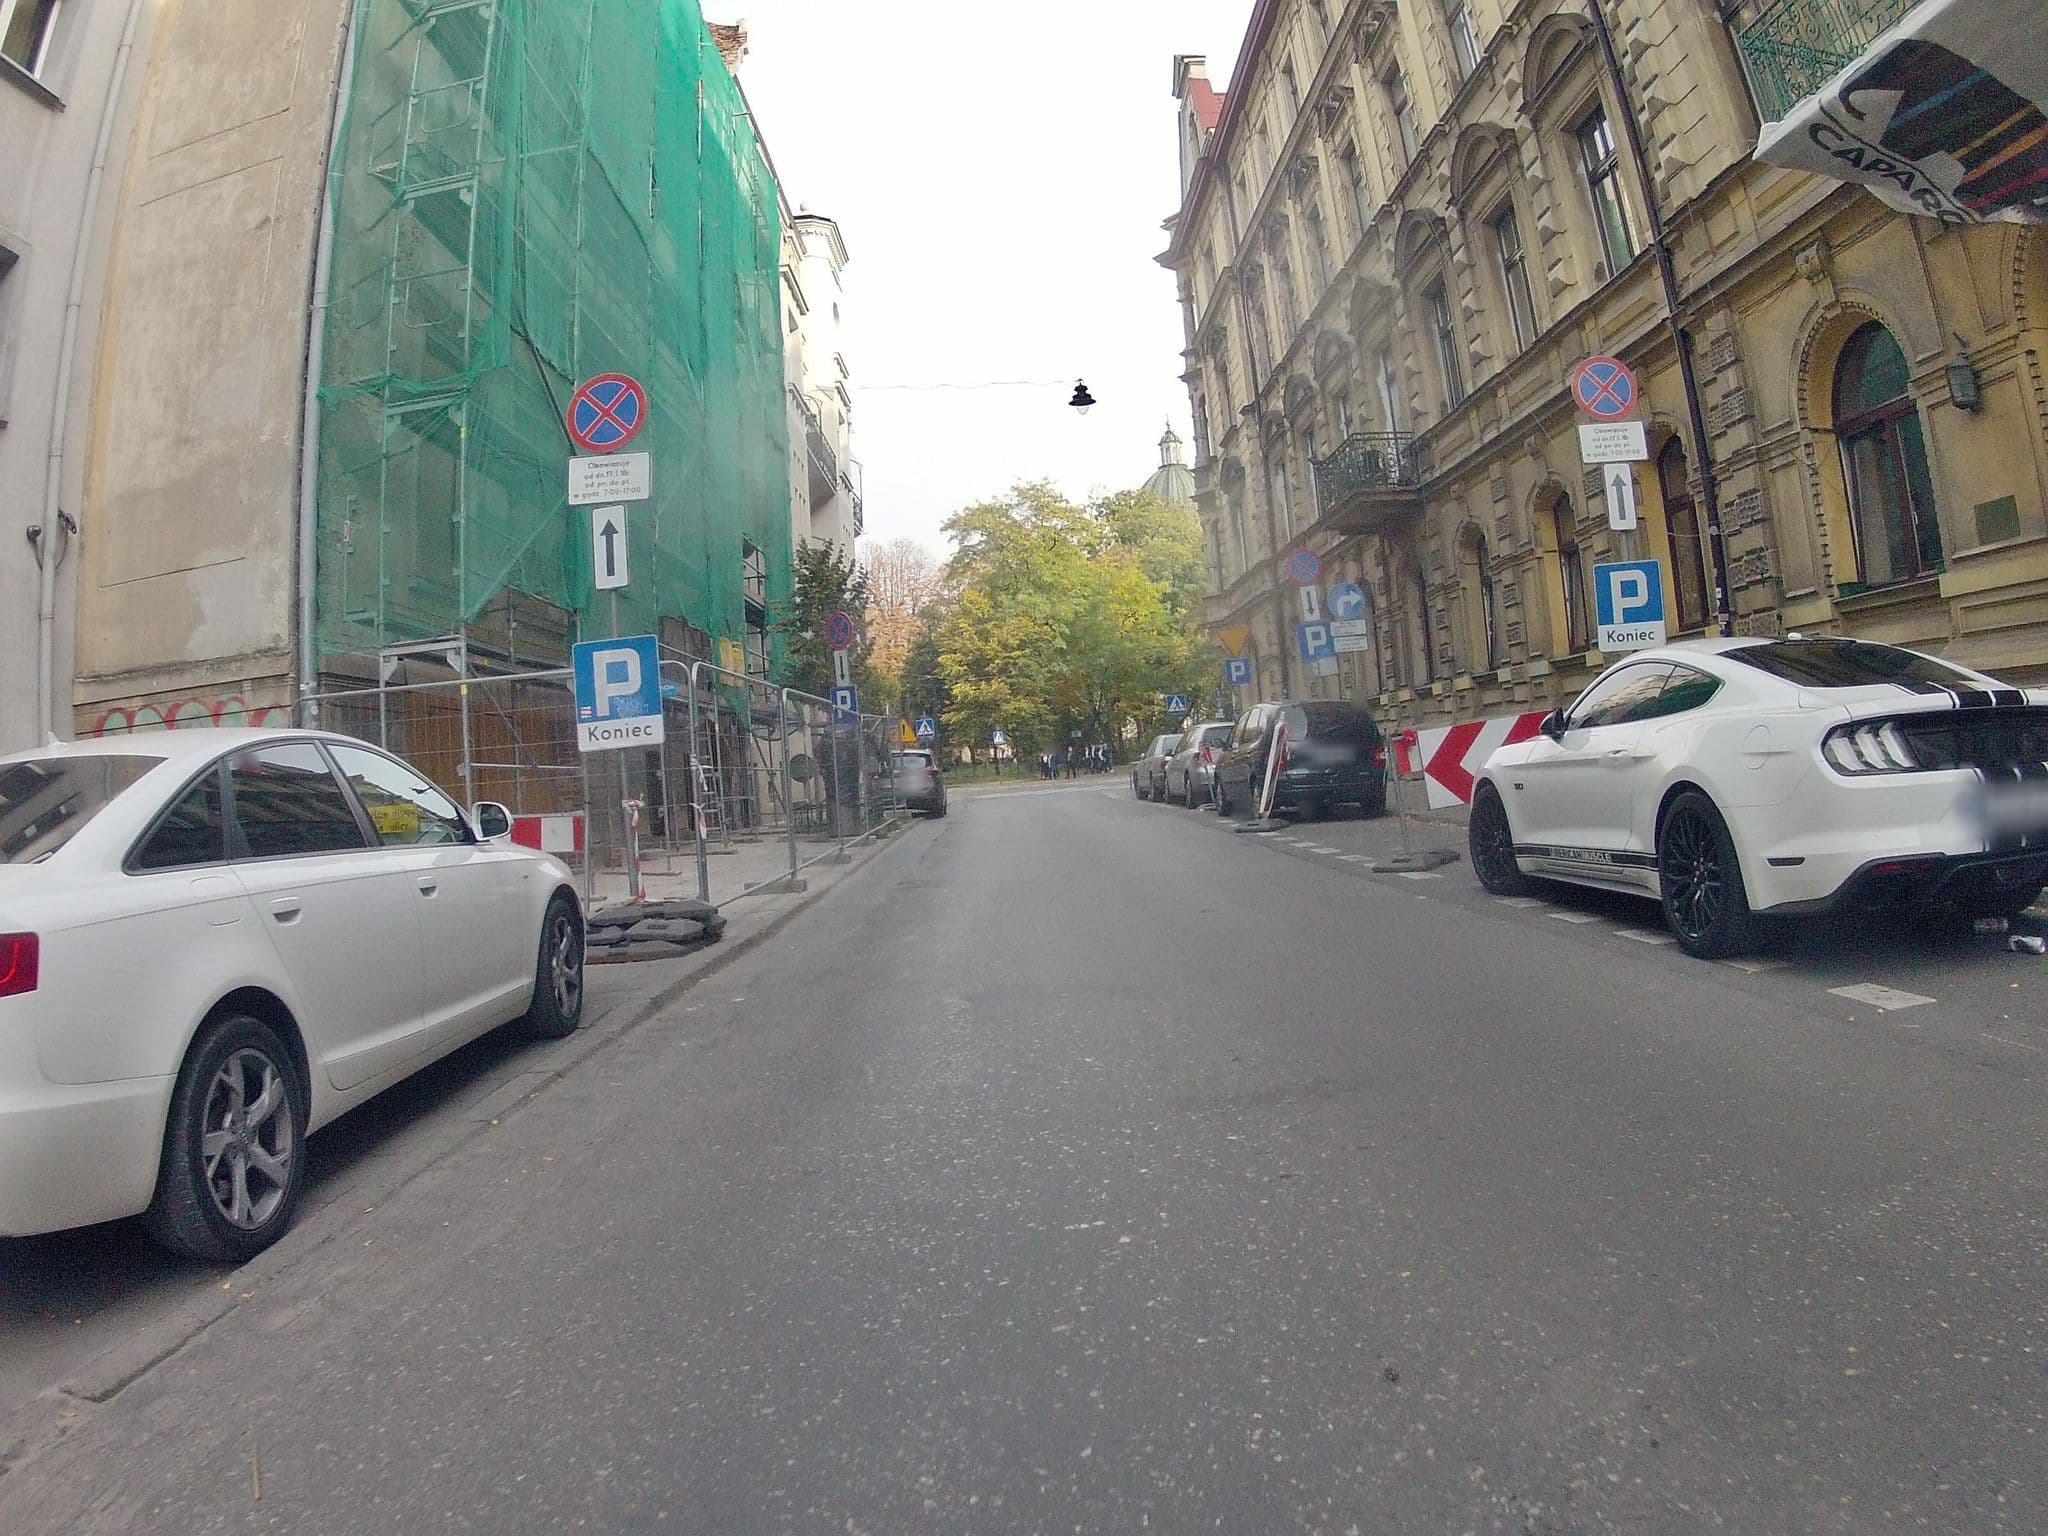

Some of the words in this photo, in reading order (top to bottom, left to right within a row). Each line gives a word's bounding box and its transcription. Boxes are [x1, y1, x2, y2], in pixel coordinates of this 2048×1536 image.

[1610, 569, 1649, 624] P
[1305, 625, 1327, 655] P
[1607, 628, 1655, 644] Koniec
[592, 647, 642, 717] P
[1231, 661, 1246, 682] P
[588, 723, 653, 742] Koniec
